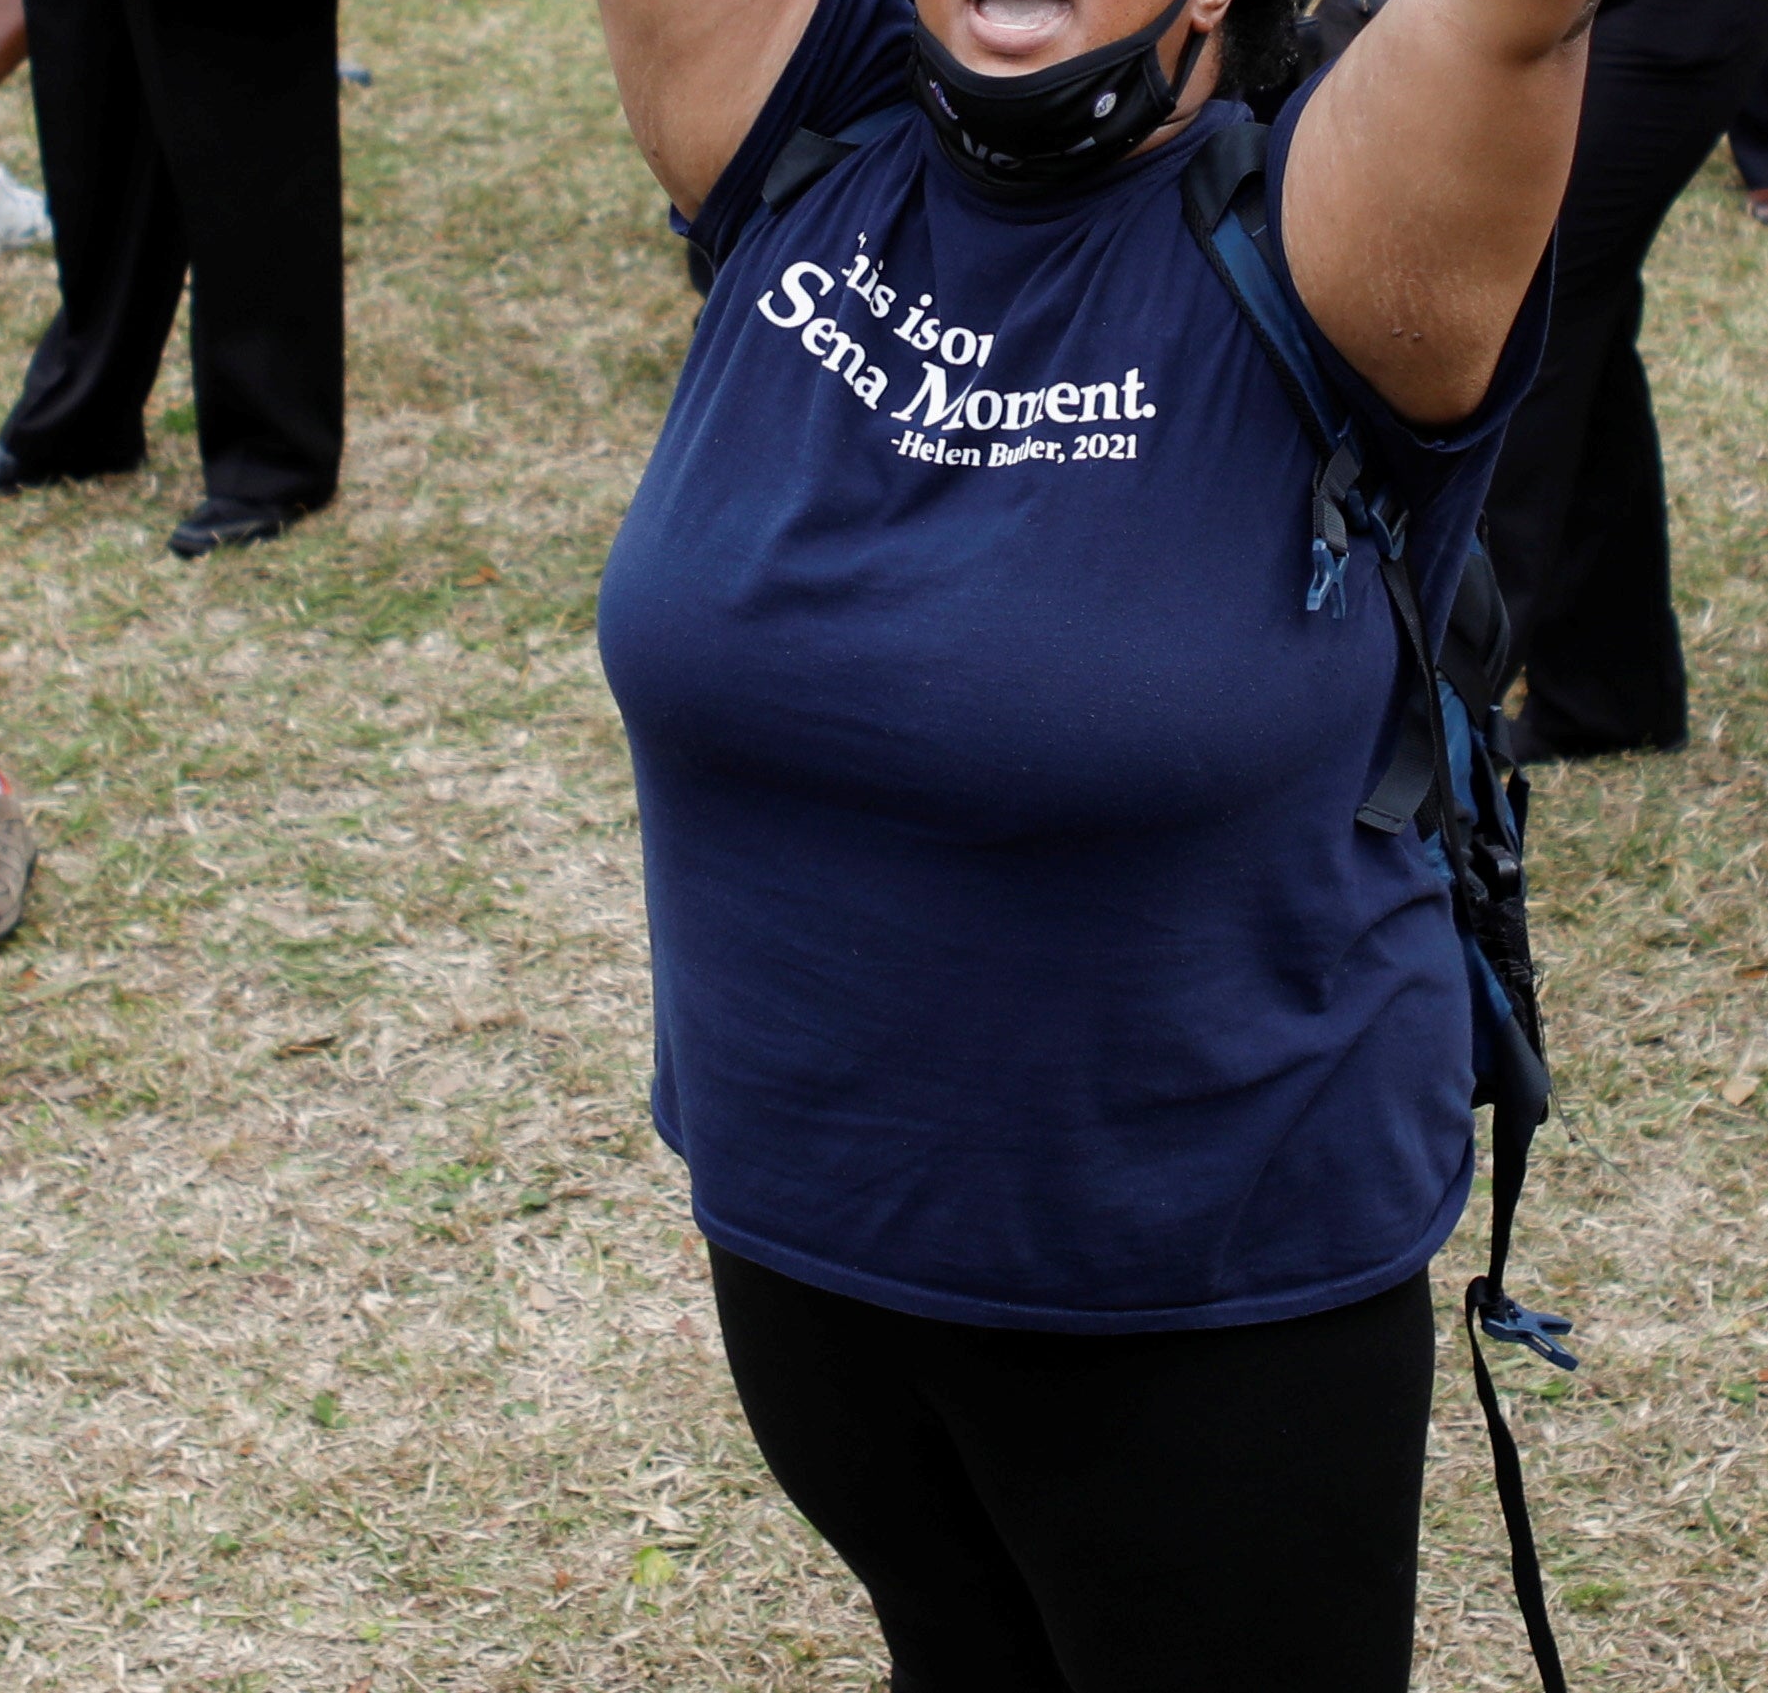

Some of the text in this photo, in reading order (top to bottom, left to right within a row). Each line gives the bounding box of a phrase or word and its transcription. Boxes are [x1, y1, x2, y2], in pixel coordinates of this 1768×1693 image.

[756, 260, 1157, 432] Sena Moment.
[1071, 433, 1138, 461] 2021
